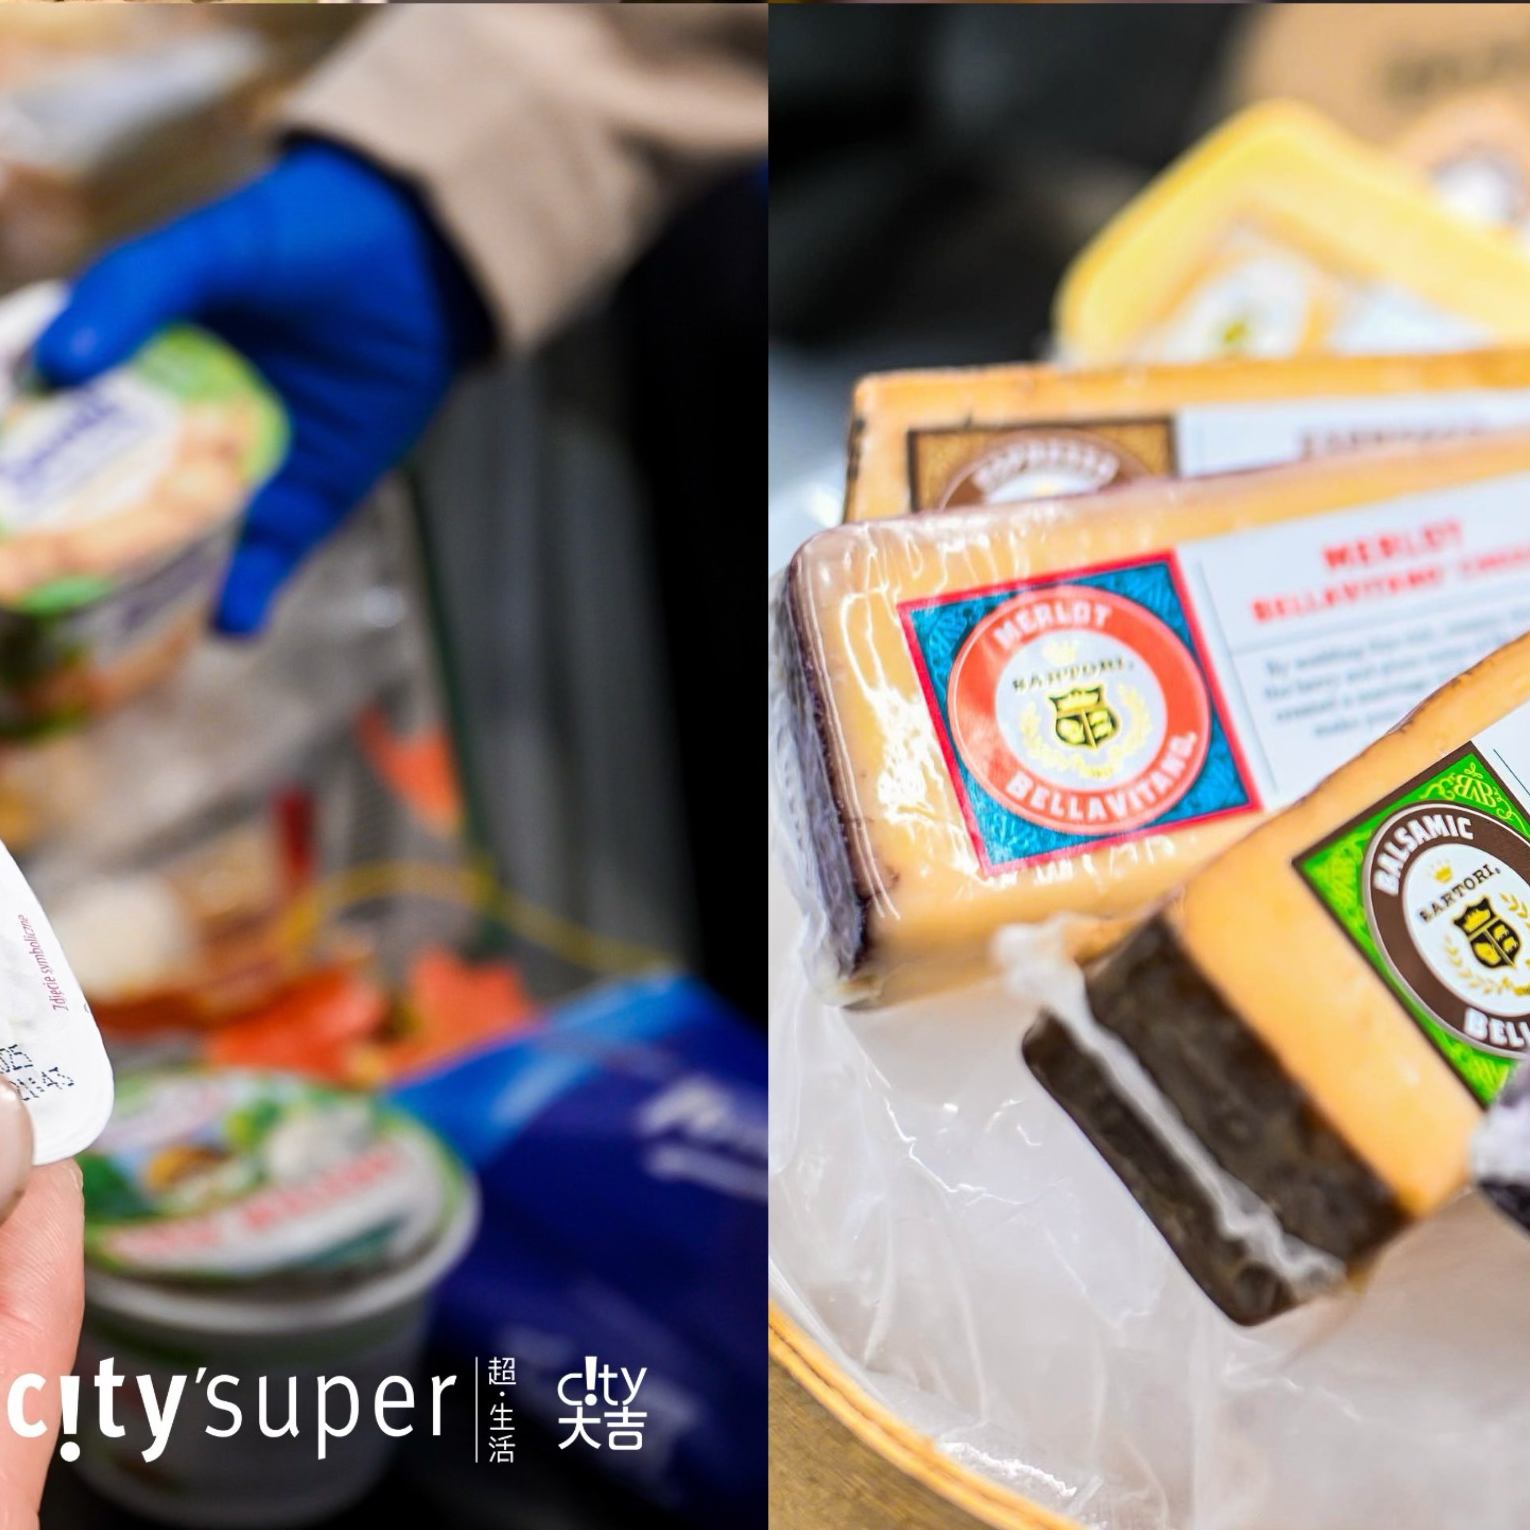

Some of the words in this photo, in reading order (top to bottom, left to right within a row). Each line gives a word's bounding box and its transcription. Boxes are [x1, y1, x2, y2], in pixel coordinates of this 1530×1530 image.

[993, 599, 1113, 651] MERLOT
[1372, 814, 1474, 897] BALSAMIC
[1418, 864, 1494, 923] SARTORI
